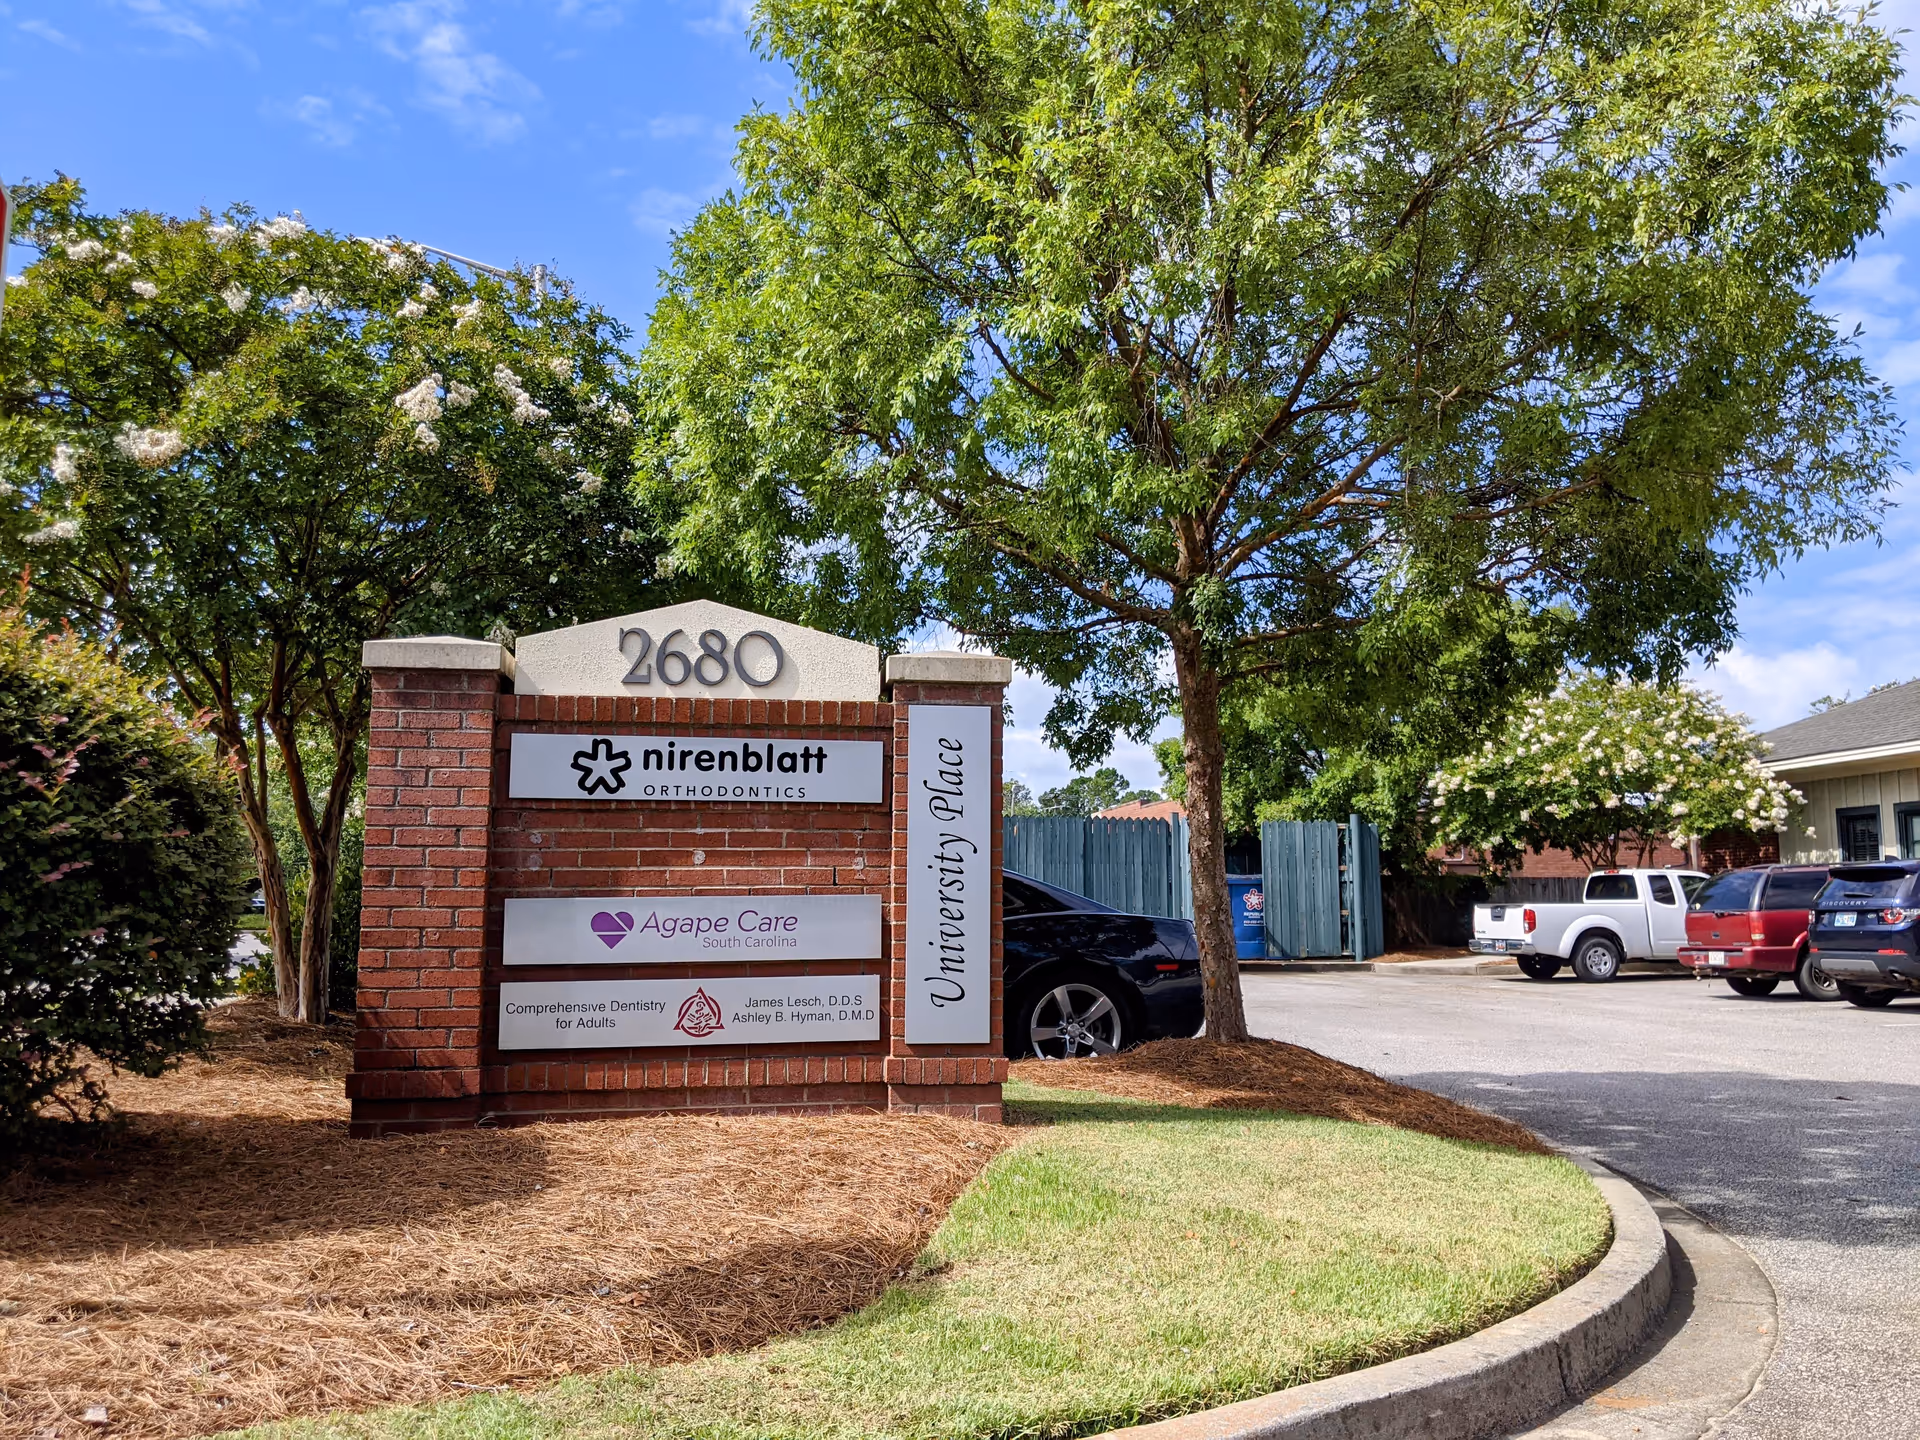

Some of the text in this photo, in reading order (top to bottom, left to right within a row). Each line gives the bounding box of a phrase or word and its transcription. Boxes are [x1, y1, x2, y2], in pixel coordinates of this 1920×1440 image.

[619, 627, 784, 687] 2680
[643, 741, 828, 773] nirenblatt
[643, 784, 806, 798] ORTHODONTICS
[923, 737, 978, 1008] University Place
[640, 910, 798, 939] Agape Care
[702, 936, 797, 948] South Carolina
[505, 1000, 666, 1016] Comprehensive Dentistry
[744, 995, 863, 1008] James Lesch, D.D.S
[555, 1017, 616, 1029] for Adults
[732, 1010, 875, 1025] Ashley B. Hyman, D.M.D
